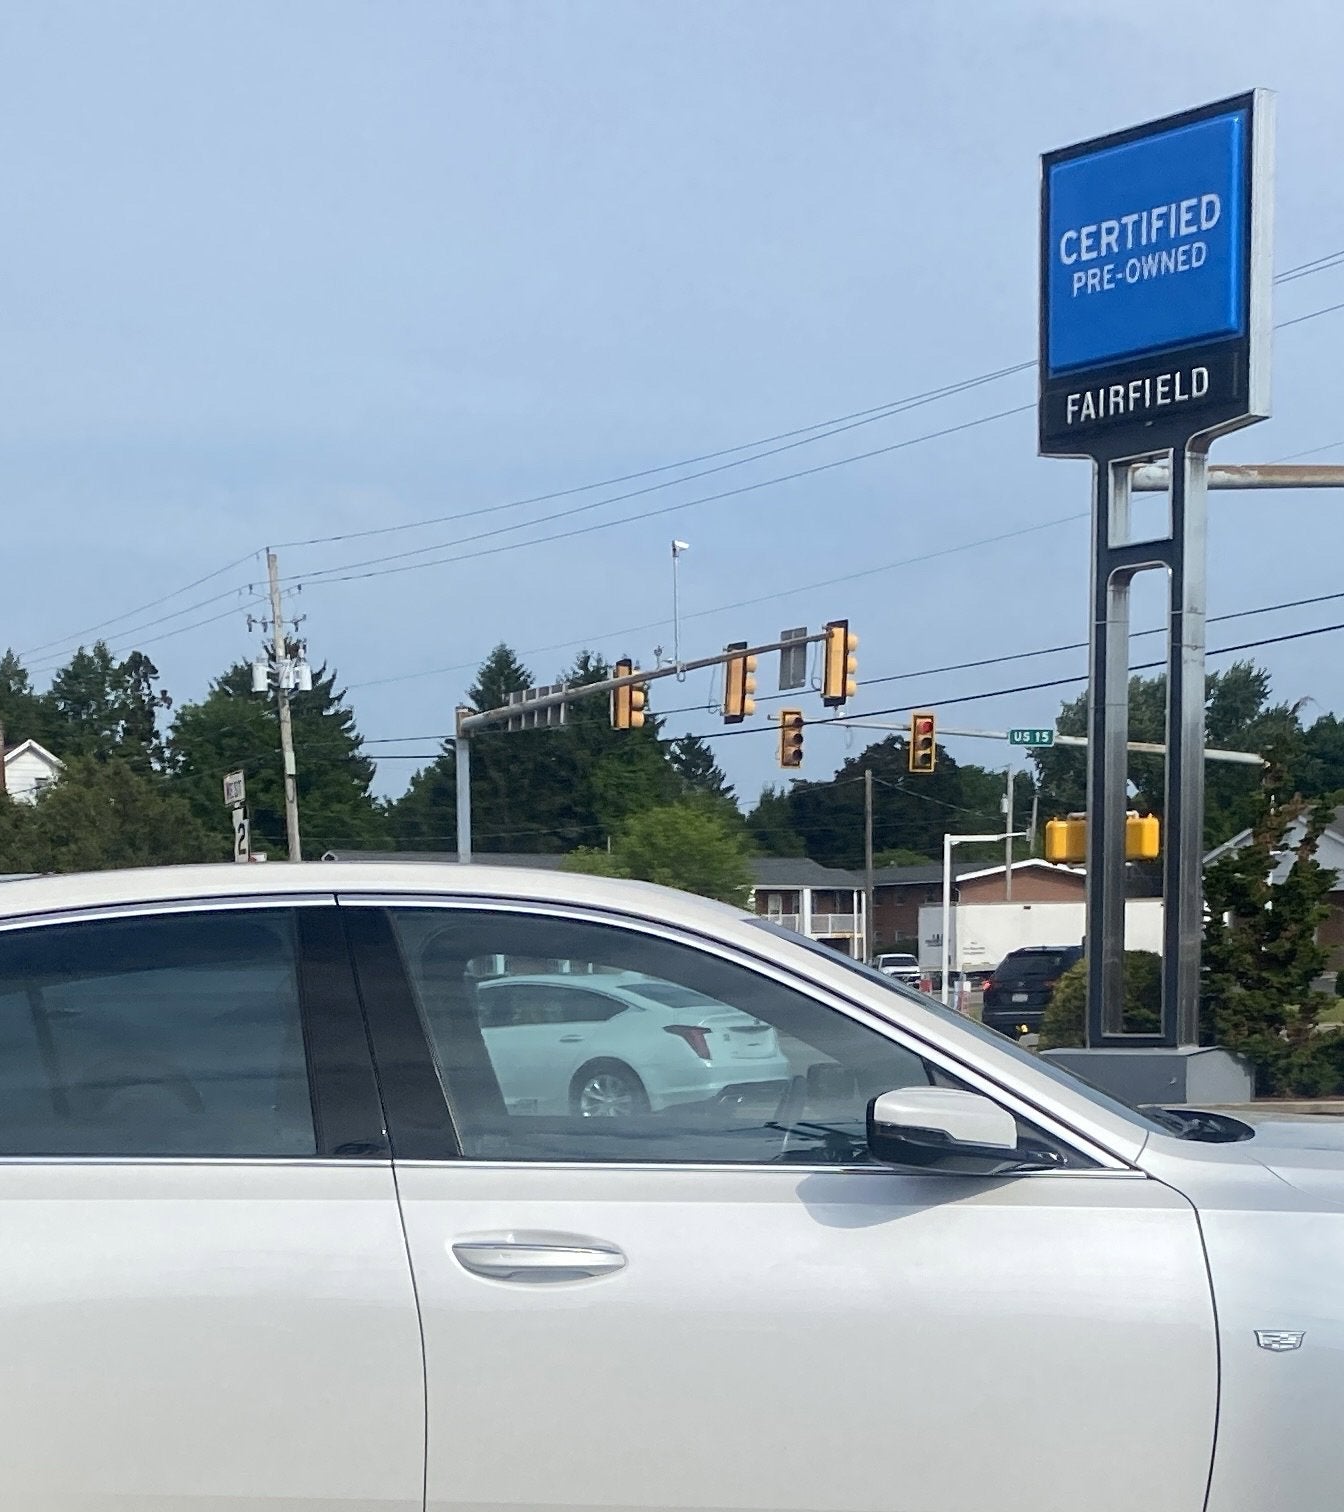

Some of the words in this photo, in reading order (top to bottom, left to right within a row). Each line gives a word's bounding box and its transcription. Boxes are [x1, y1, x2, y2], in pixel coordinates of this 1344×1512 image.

[1060, 193, 1222, 266] CERTIFIED
[1072, 241, 1208, 298] PRE-OWNED
[1066, 367, 1209, 425] FAIRFIELD
[1014, 731, 1031, 742] US
[1035, 731, 1050, 743] 15
